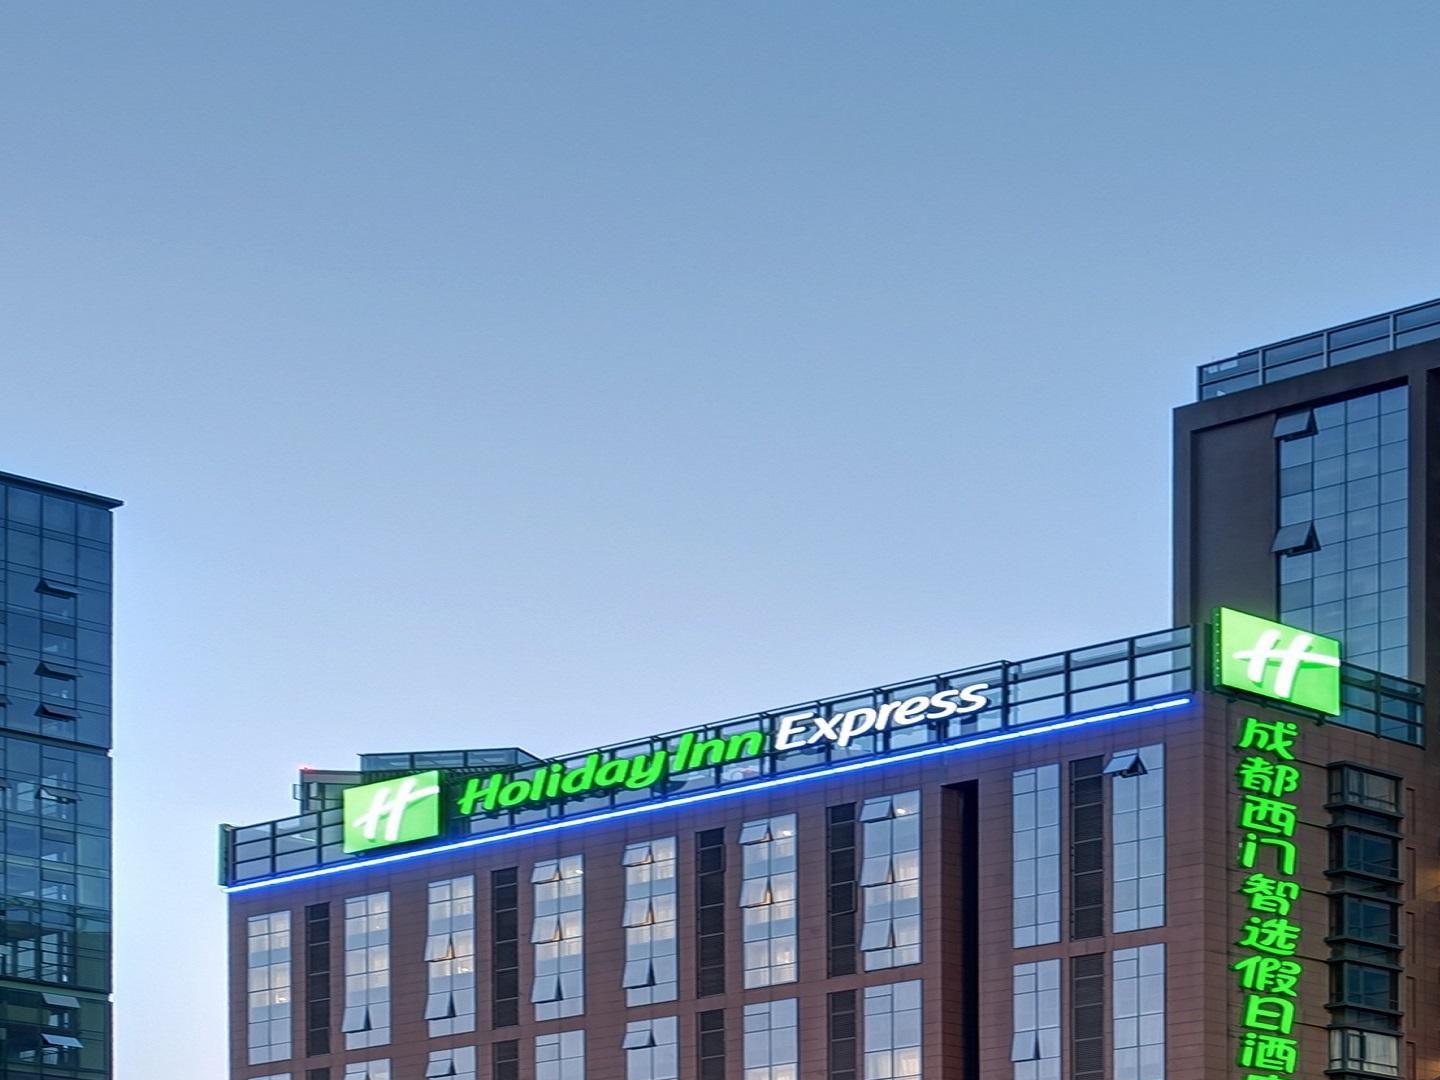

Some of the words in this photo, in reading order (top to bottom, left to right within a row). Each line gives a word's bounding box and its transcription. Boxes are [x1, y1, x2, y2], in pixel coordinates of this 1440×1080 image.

[457, 745, 667, 815] Holiday
[671, 732, 765, 772] Inn
[774, 682, 990, 752] Express
